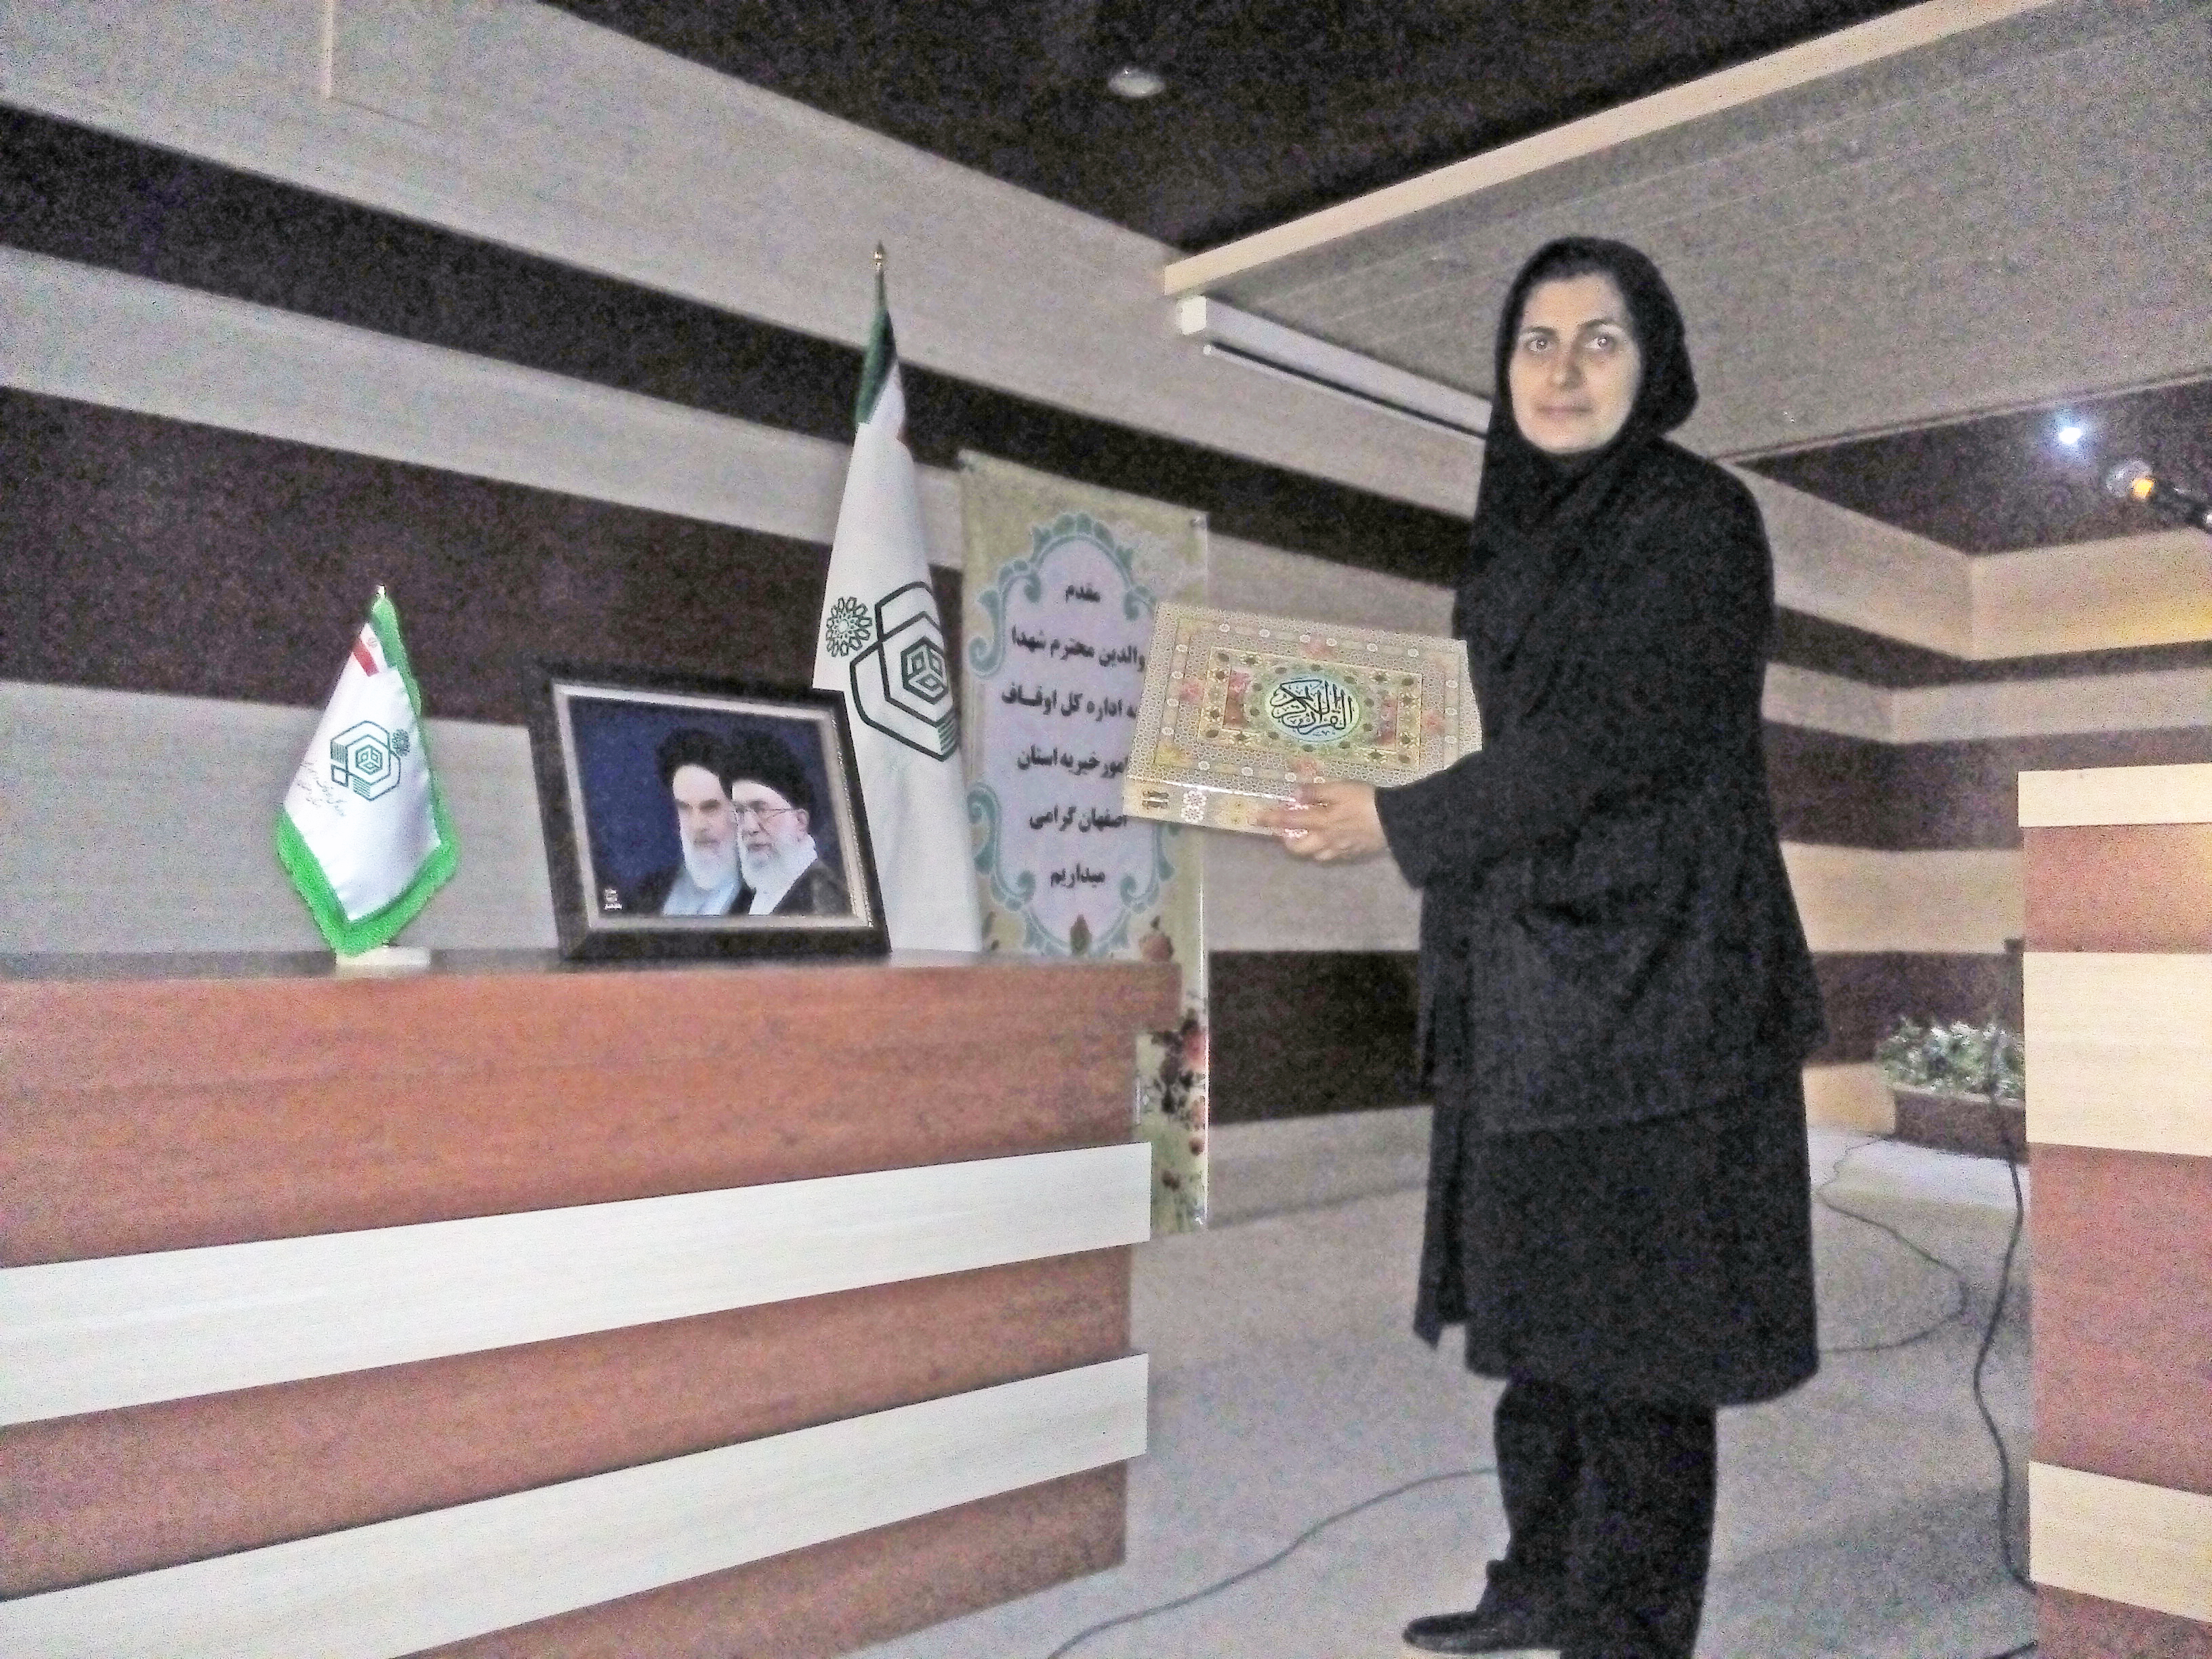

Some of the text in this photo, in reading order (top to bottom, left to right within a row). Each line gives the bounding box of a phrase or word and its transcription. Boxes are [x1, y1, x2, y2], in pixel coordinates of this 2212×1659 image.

[1065, 583, 1101, 603] مقدم
[1012, 625, 1145, 672] والدین محترم شهدا
[1002, 682, 1057, 716] اوقاف
[1086, 697, 1123, 722] اداره
[1018, 743, 1058, 771] استان
[1029, 804, 1077, 832] گرامی
[1050, 863, 1105, 889] میداریم
